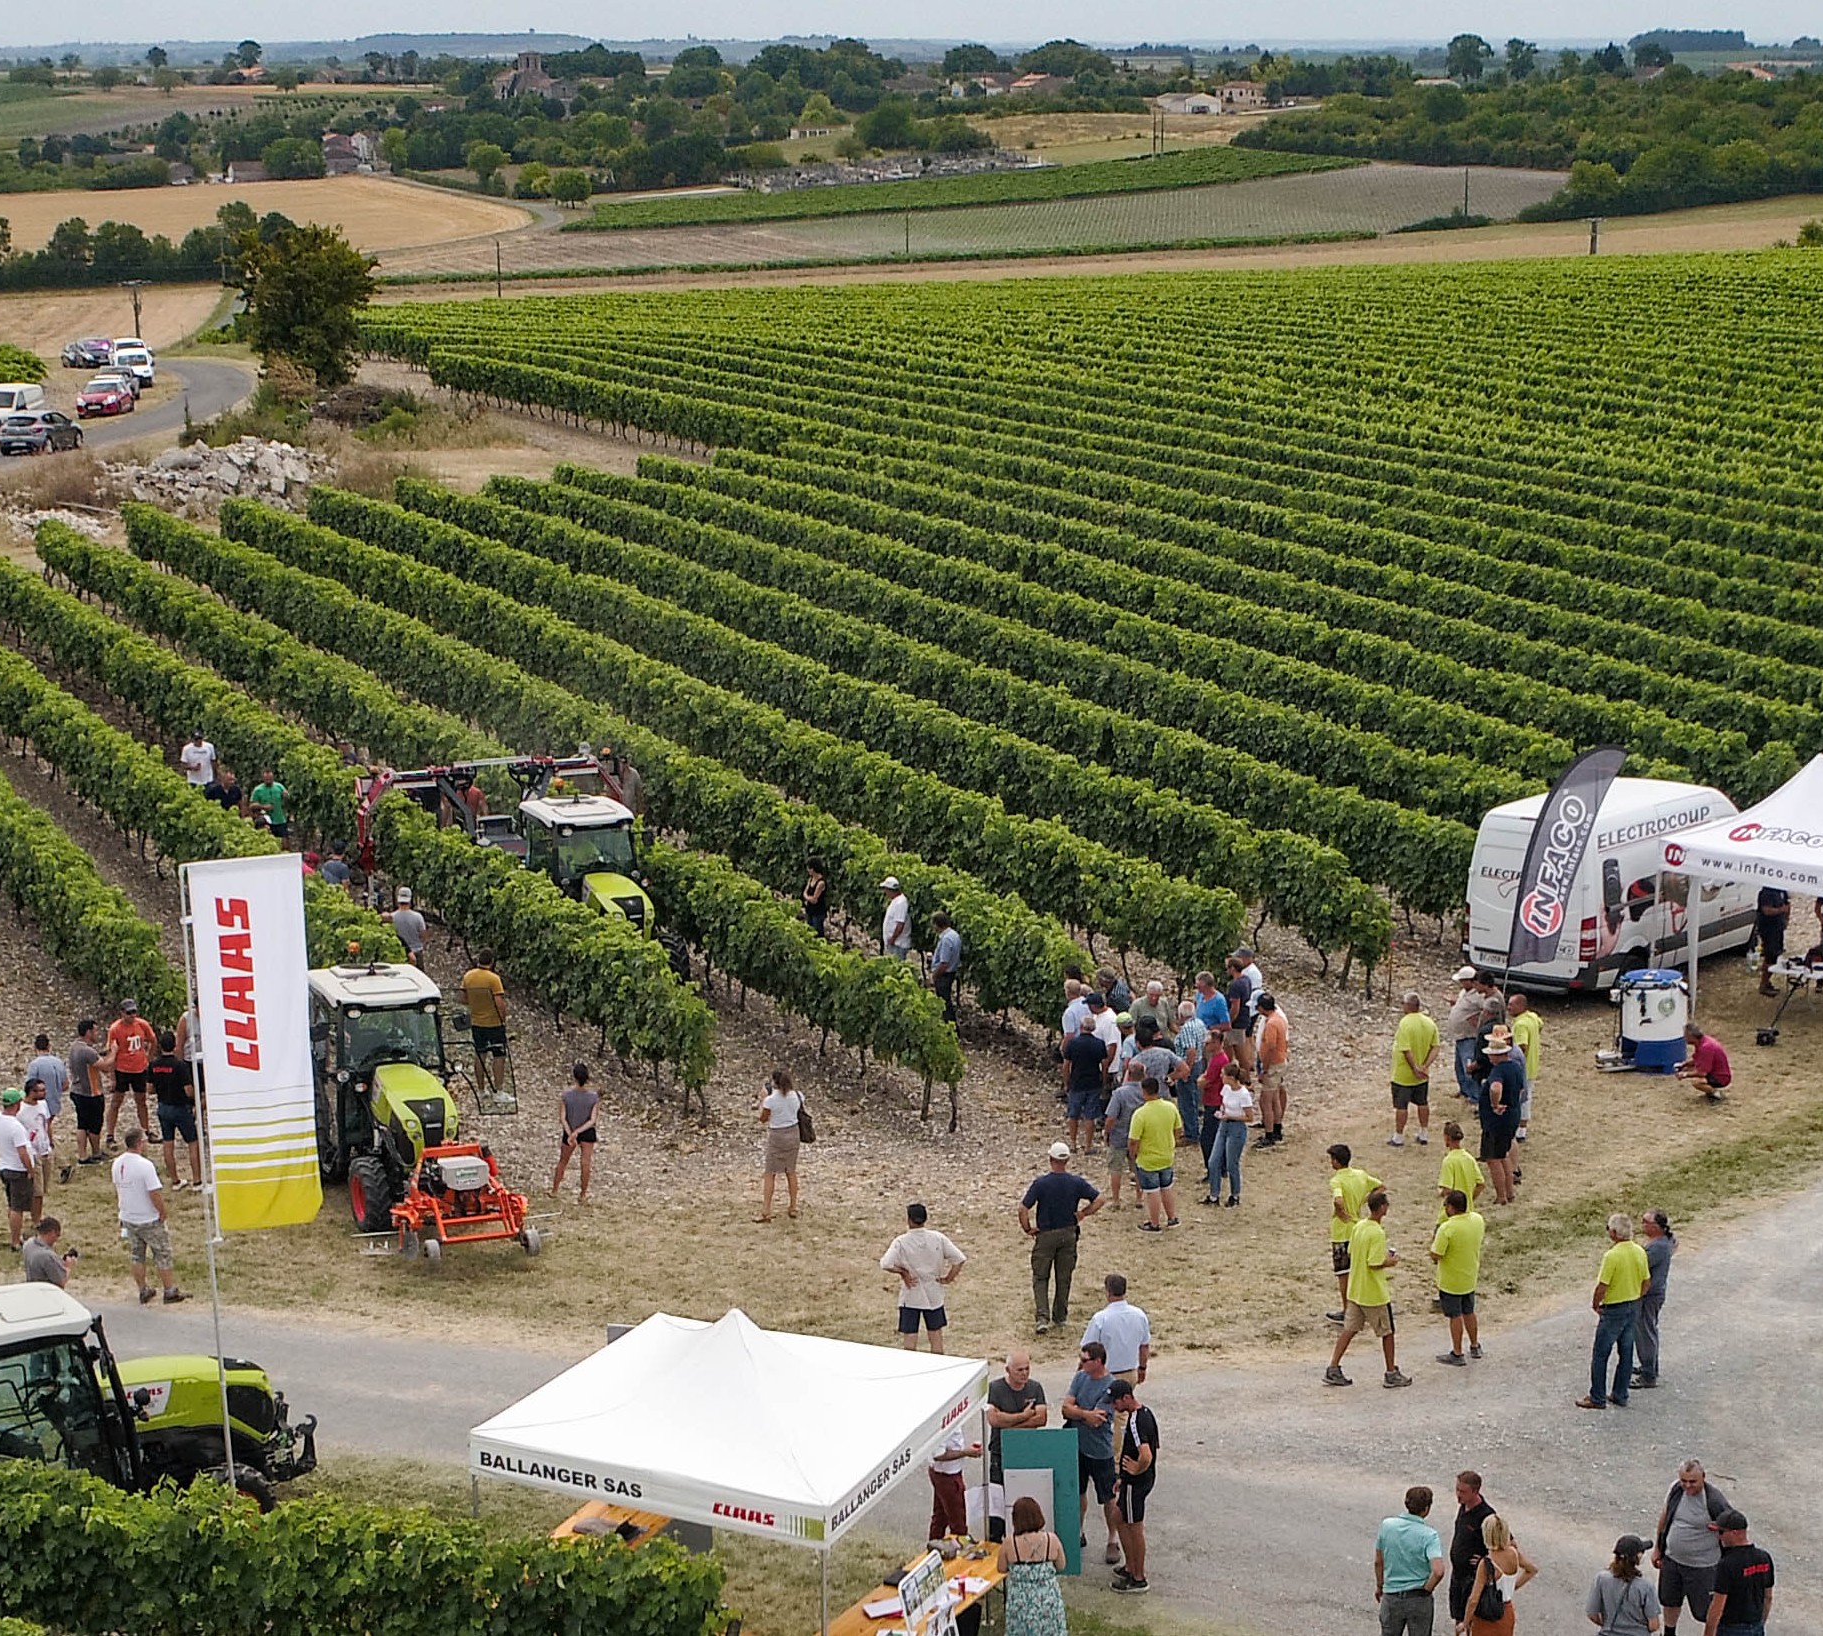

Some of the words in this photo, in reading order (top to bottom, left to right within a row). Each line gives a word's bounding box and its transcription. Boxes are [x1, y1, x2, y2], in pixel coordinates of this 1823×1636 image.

[1598, 806, 1711, 849] ELECTROCOUP
[1525, 796, 1586, 936] INFACO
[1666, 846, 1686, 864] IN
[1701, 857, 1819, 885] www.infaco.com
[215, 897, 261, 1072] CLAAS
[941, 1396, 969, 1430] CLAAS
[480, 1451, 598, 1490] BALLANGER
[603, 1477, 643, 1498] SAS
[831, 1466, 890, 1532] BALLANGER
[891, 1447, 912, 1475] SAS
[712, 1502, 776, 1527] CLAAS
